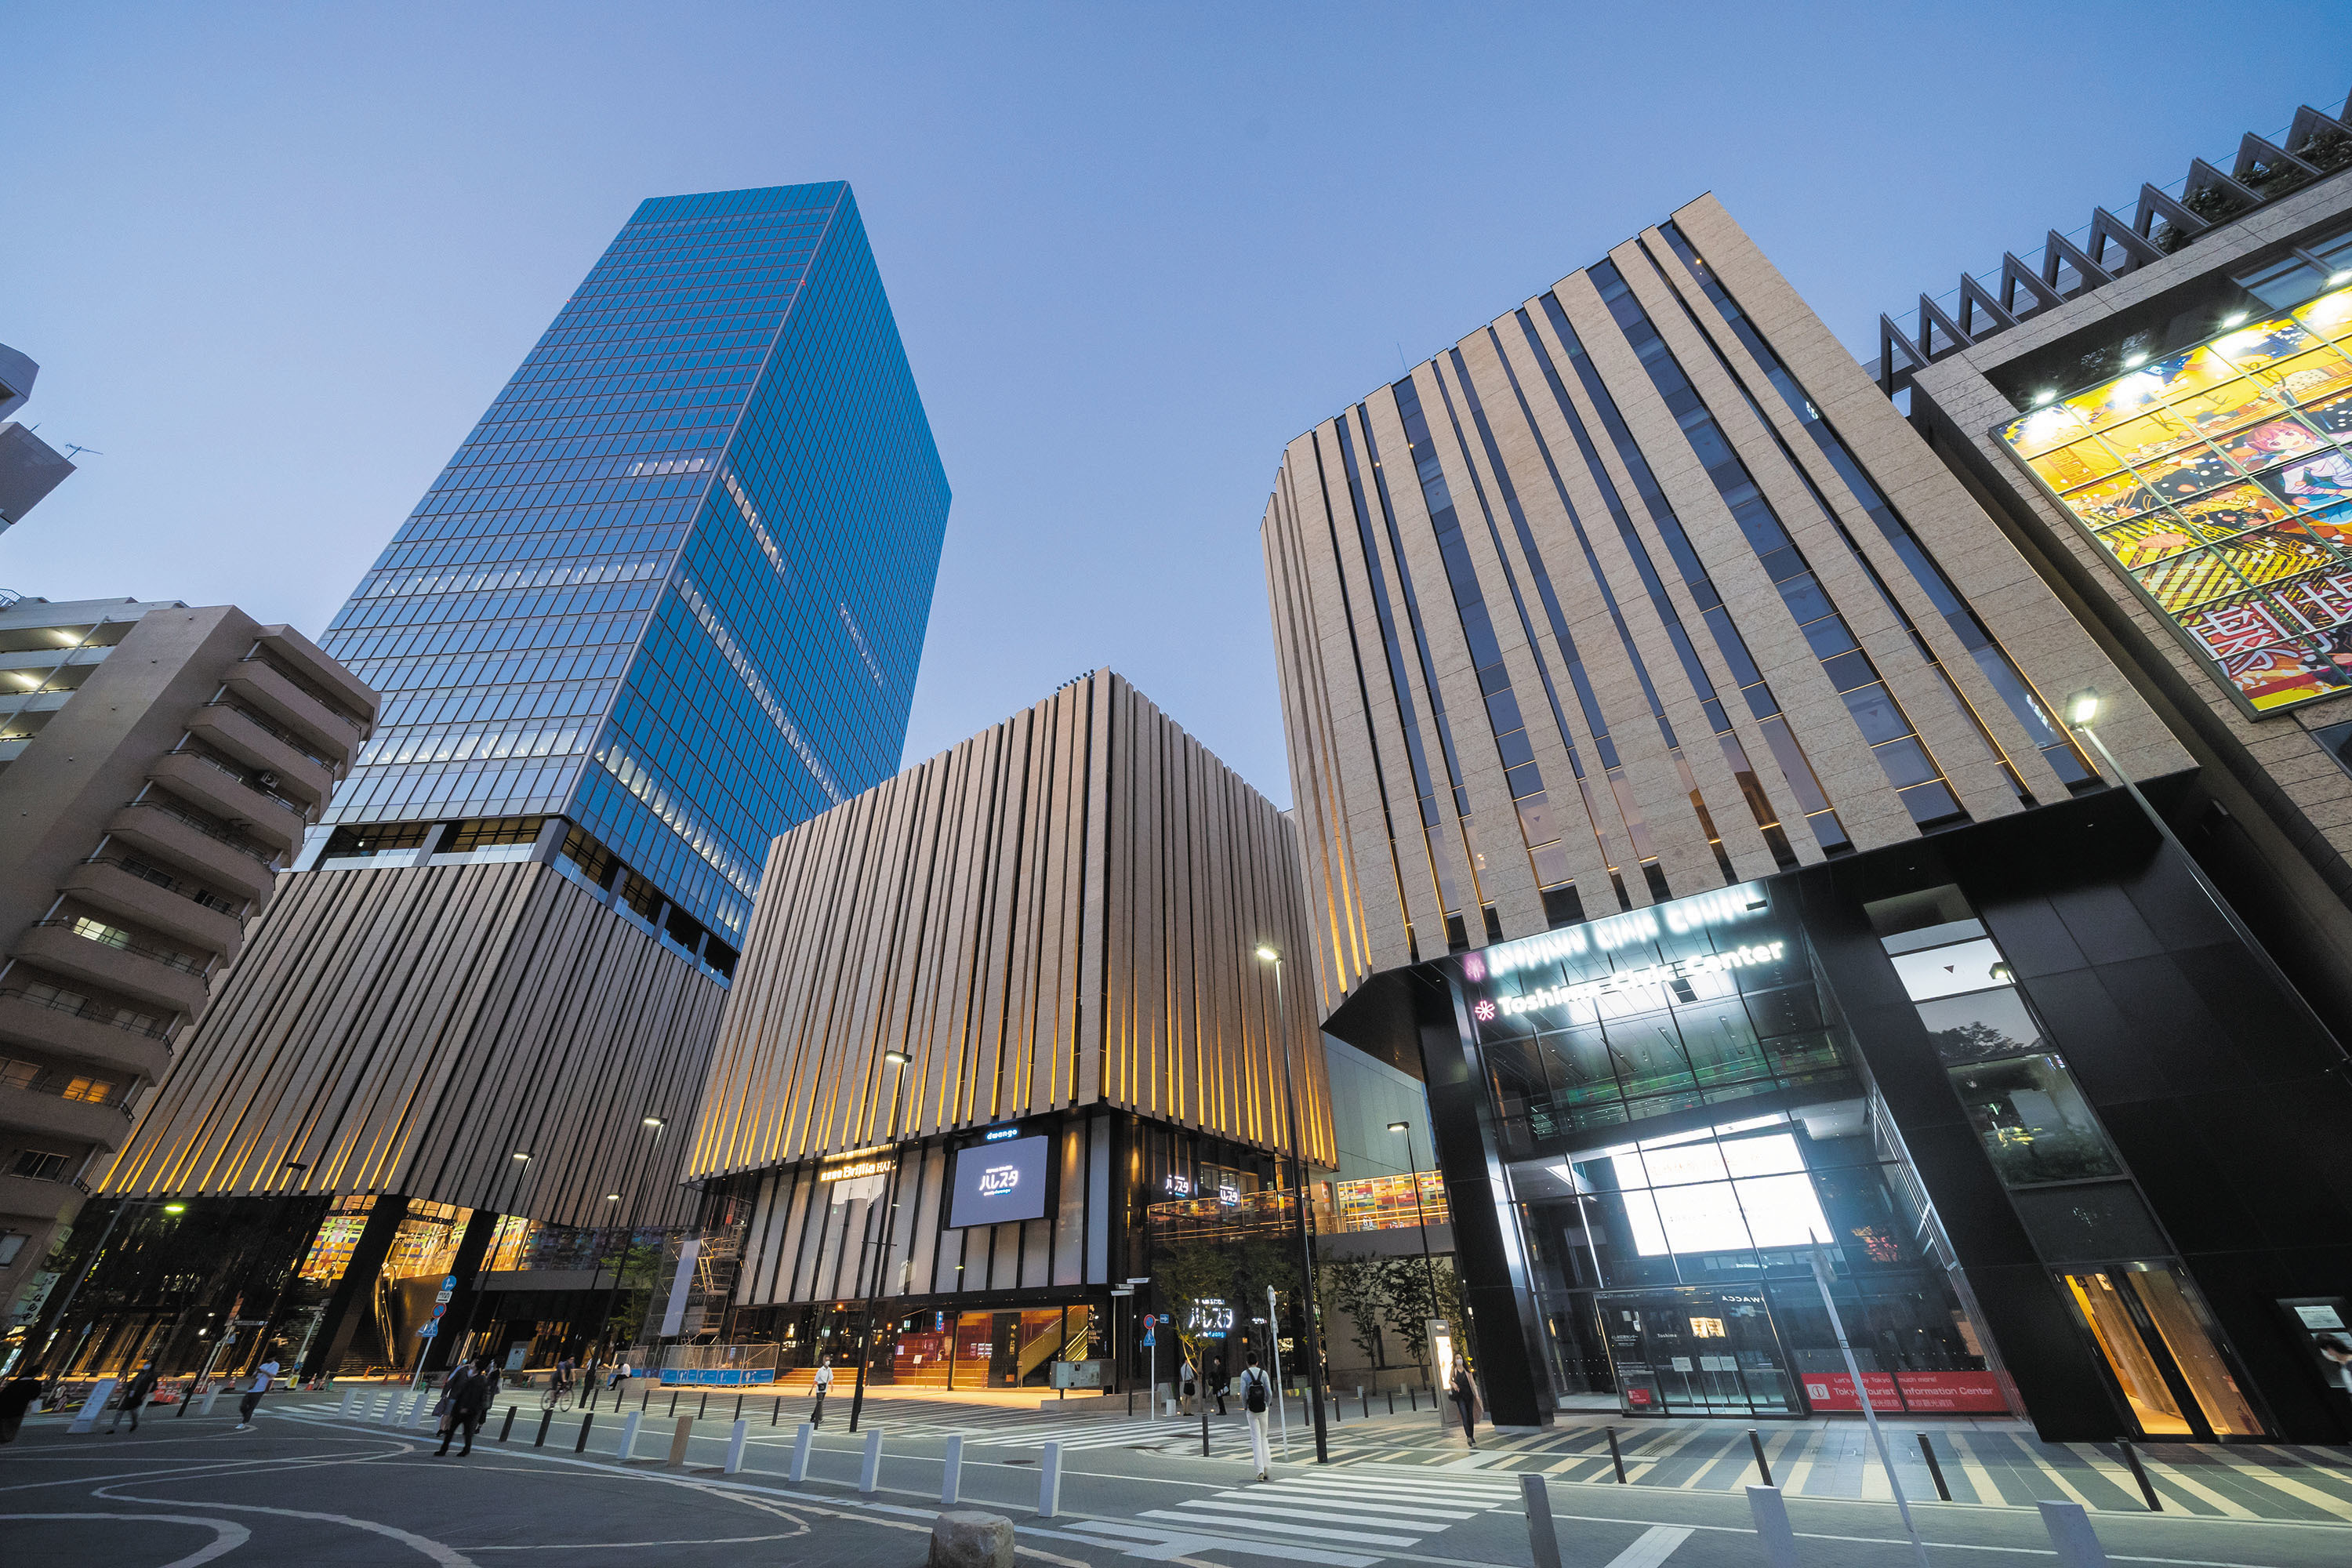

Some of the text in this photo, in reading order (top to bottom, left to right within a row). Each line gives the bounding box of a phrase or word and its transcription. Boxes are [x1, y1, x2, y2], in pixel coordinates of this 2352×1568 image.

[1497, 941, 1784, 1016] Toshima Civic Center
[986, 1129, 1018, 1140] dwango
[843, 1163, 876, 1178] Brillia
[978, 1171, 1018, 1191] ハレスタ
[1865, 1387, 1896, 1396] Tourist
[1902, 1387, 1958, 1396] Information
[1958, 1386, 1994, 1396] Center
